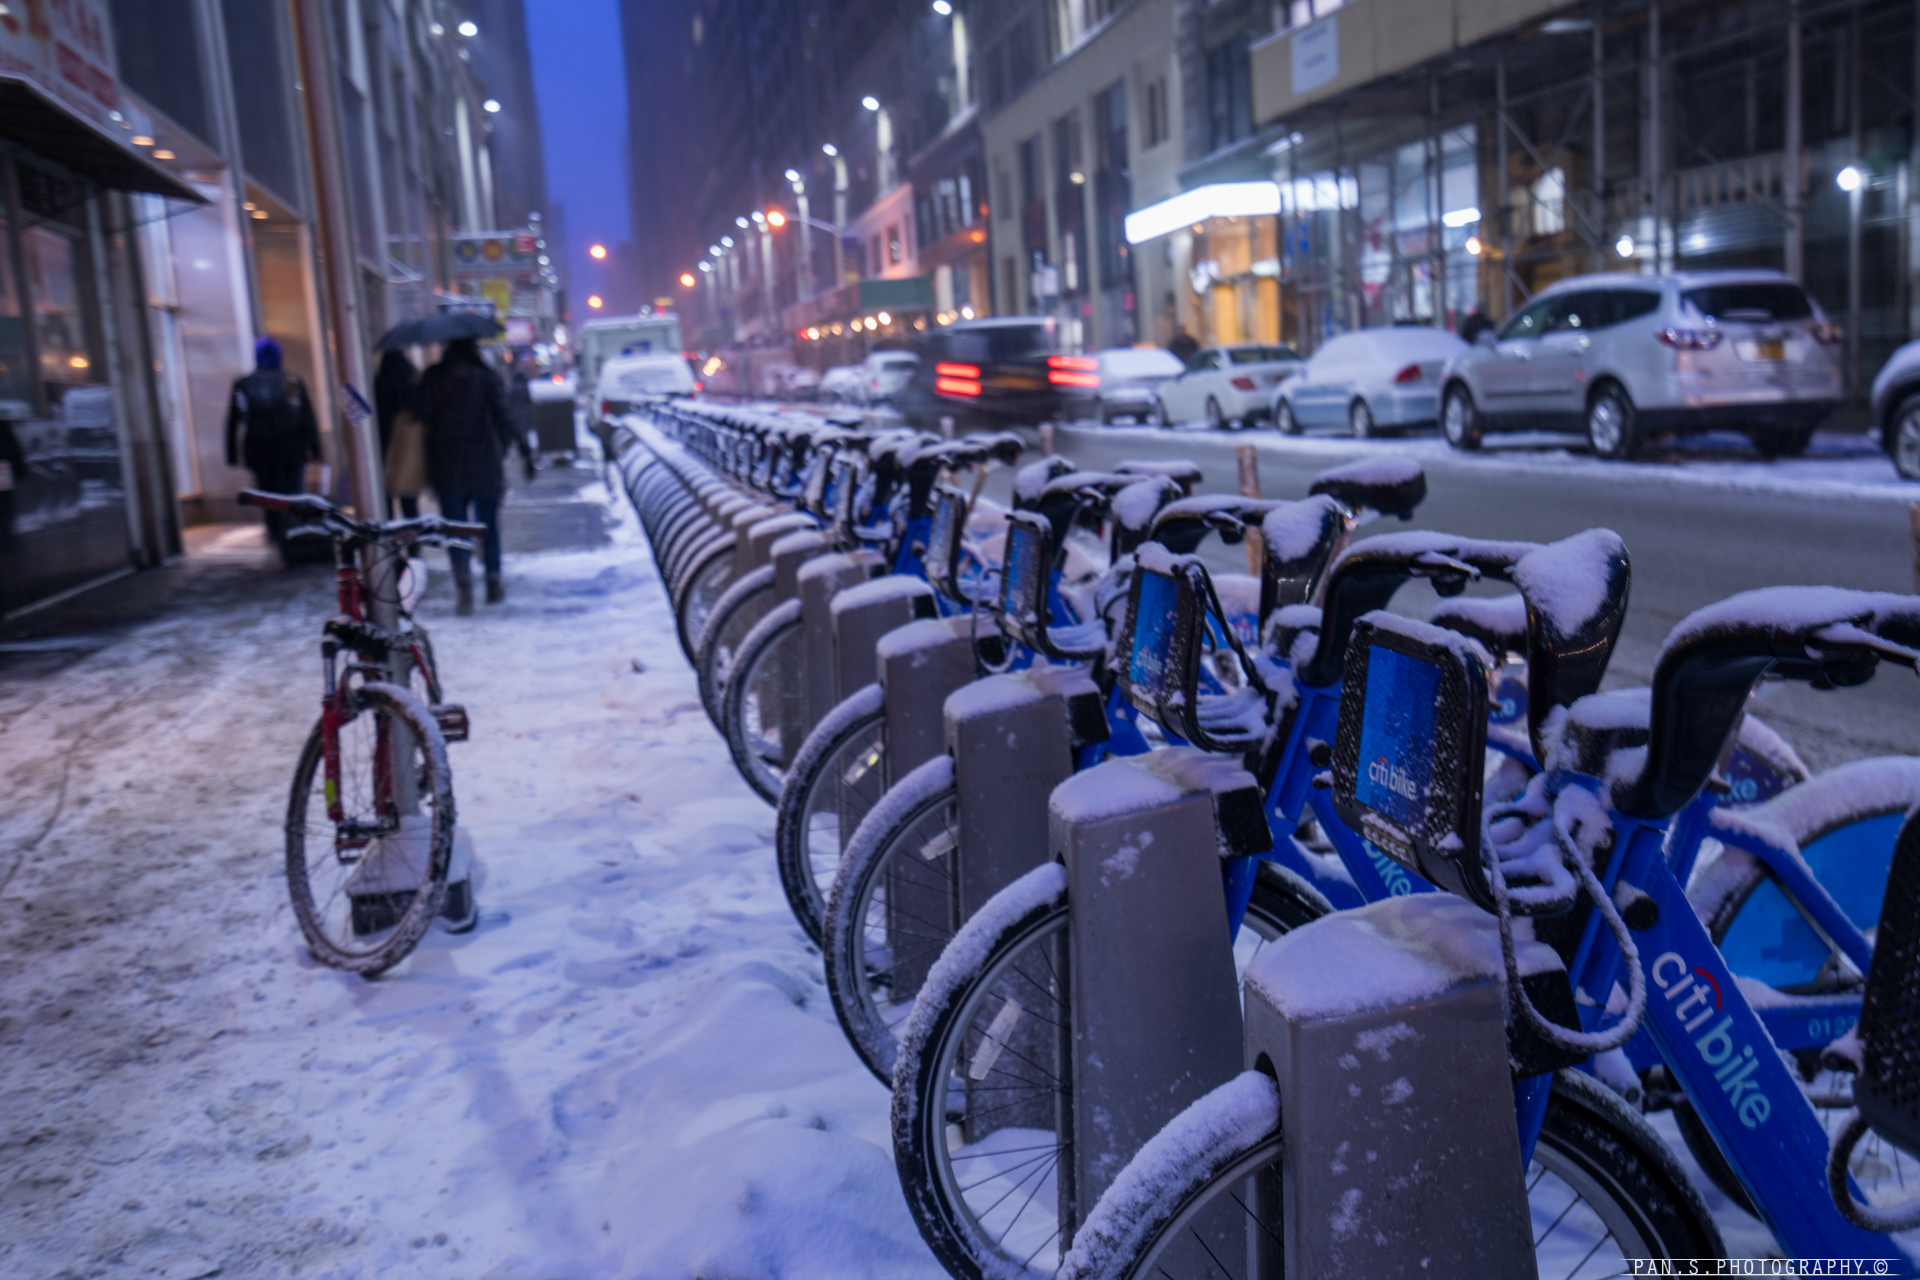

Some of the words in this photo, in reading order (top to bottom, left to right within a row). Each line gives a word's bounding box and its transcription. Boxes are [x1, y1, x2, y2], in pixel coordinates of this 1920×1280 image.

[1368, 756, 1390, 788] citi
[1389, 764, 1416, 801] bike
[1652, 951, 1721, 1034] citi
[1695, 1014, 1771, 1130] bike
